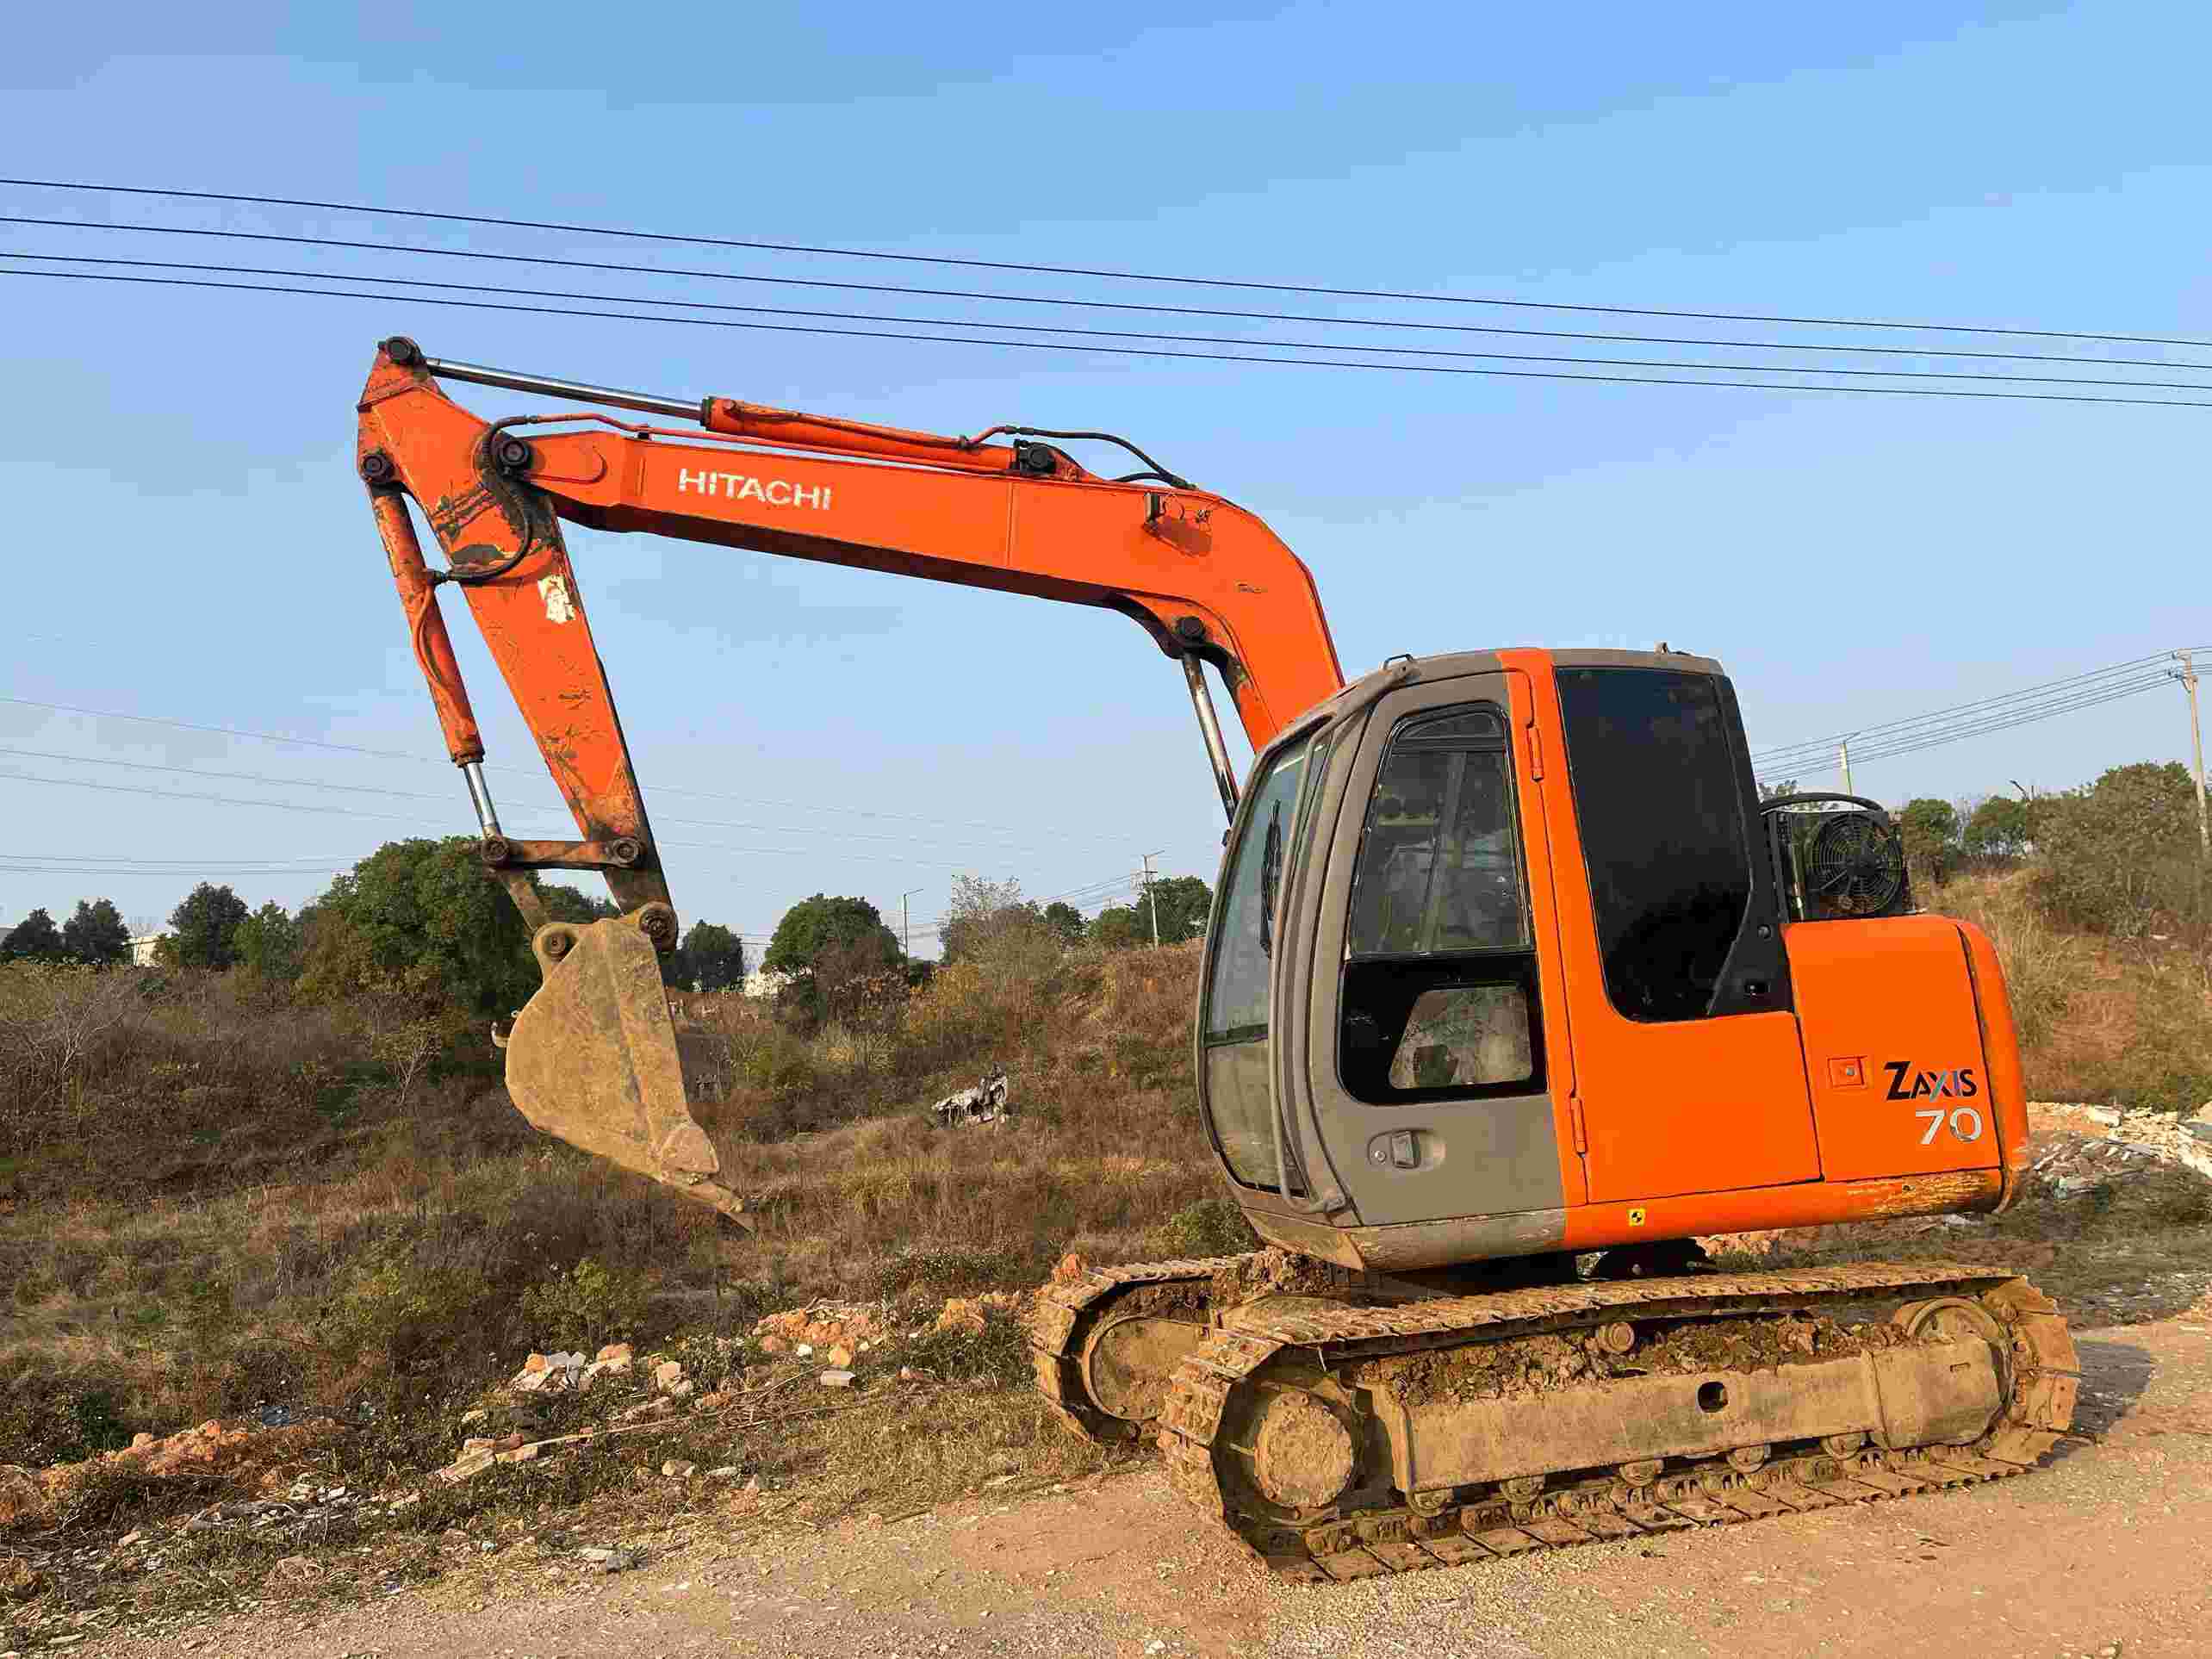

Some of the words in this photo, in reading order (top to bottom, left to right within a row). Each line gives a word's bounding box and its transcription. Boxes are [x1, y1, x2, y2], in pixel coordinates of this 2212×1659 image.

[678, 468, 833, 511] HITACHI
[1884, 1060, 1978, 1102] ZAXIS
[1915, 1107, 1983, 1145] 70
